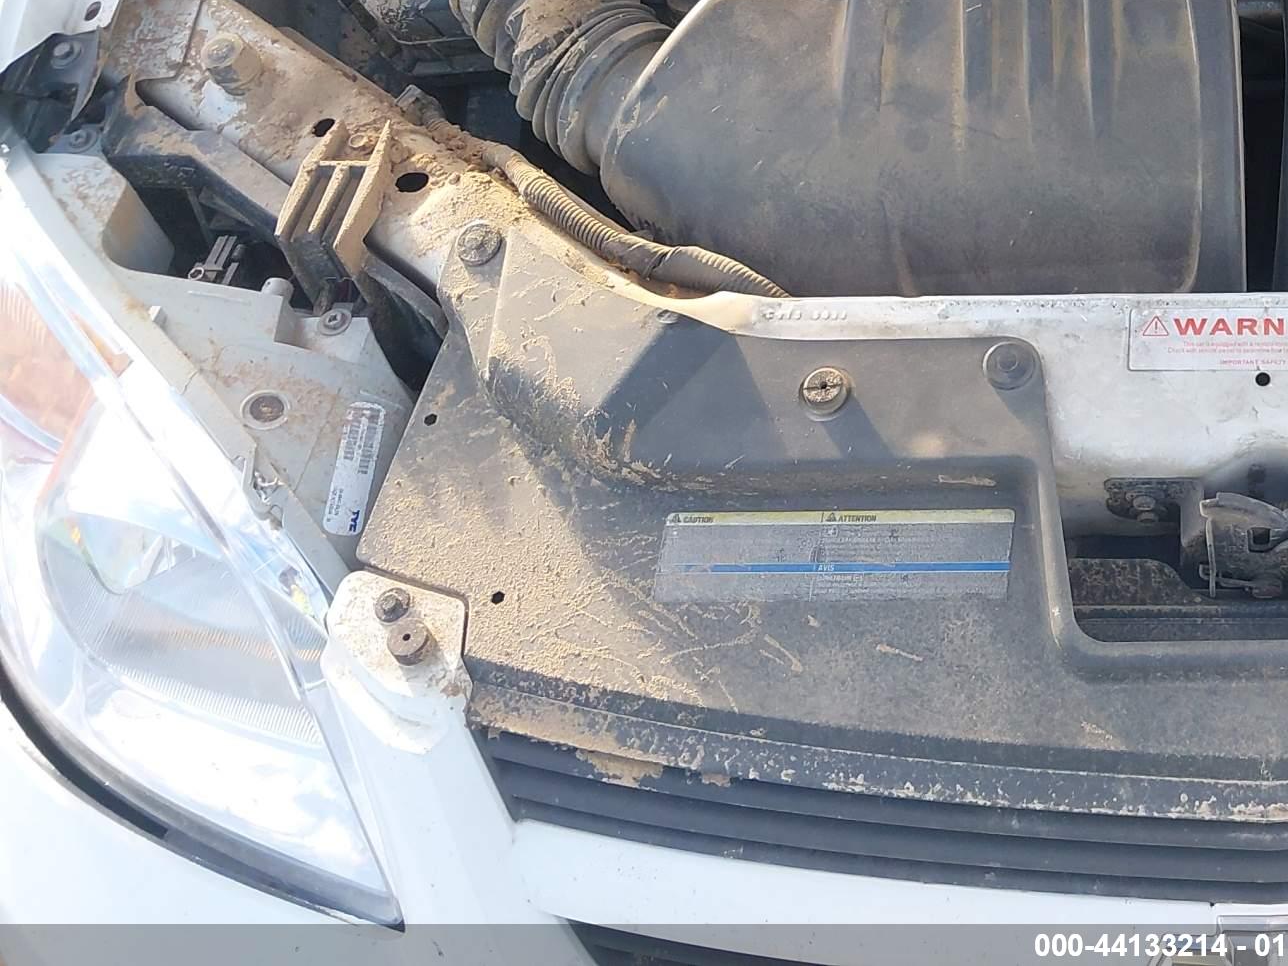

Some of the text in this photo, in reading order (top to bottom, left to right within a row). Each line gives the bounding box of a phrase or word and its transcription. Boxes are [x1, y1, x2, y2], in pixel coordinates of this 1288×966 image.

[349, 509, 361, 533] TYC
[683, 516, 714, 524] CAUTION
[838, 514, 877, 523] ATTENTION
